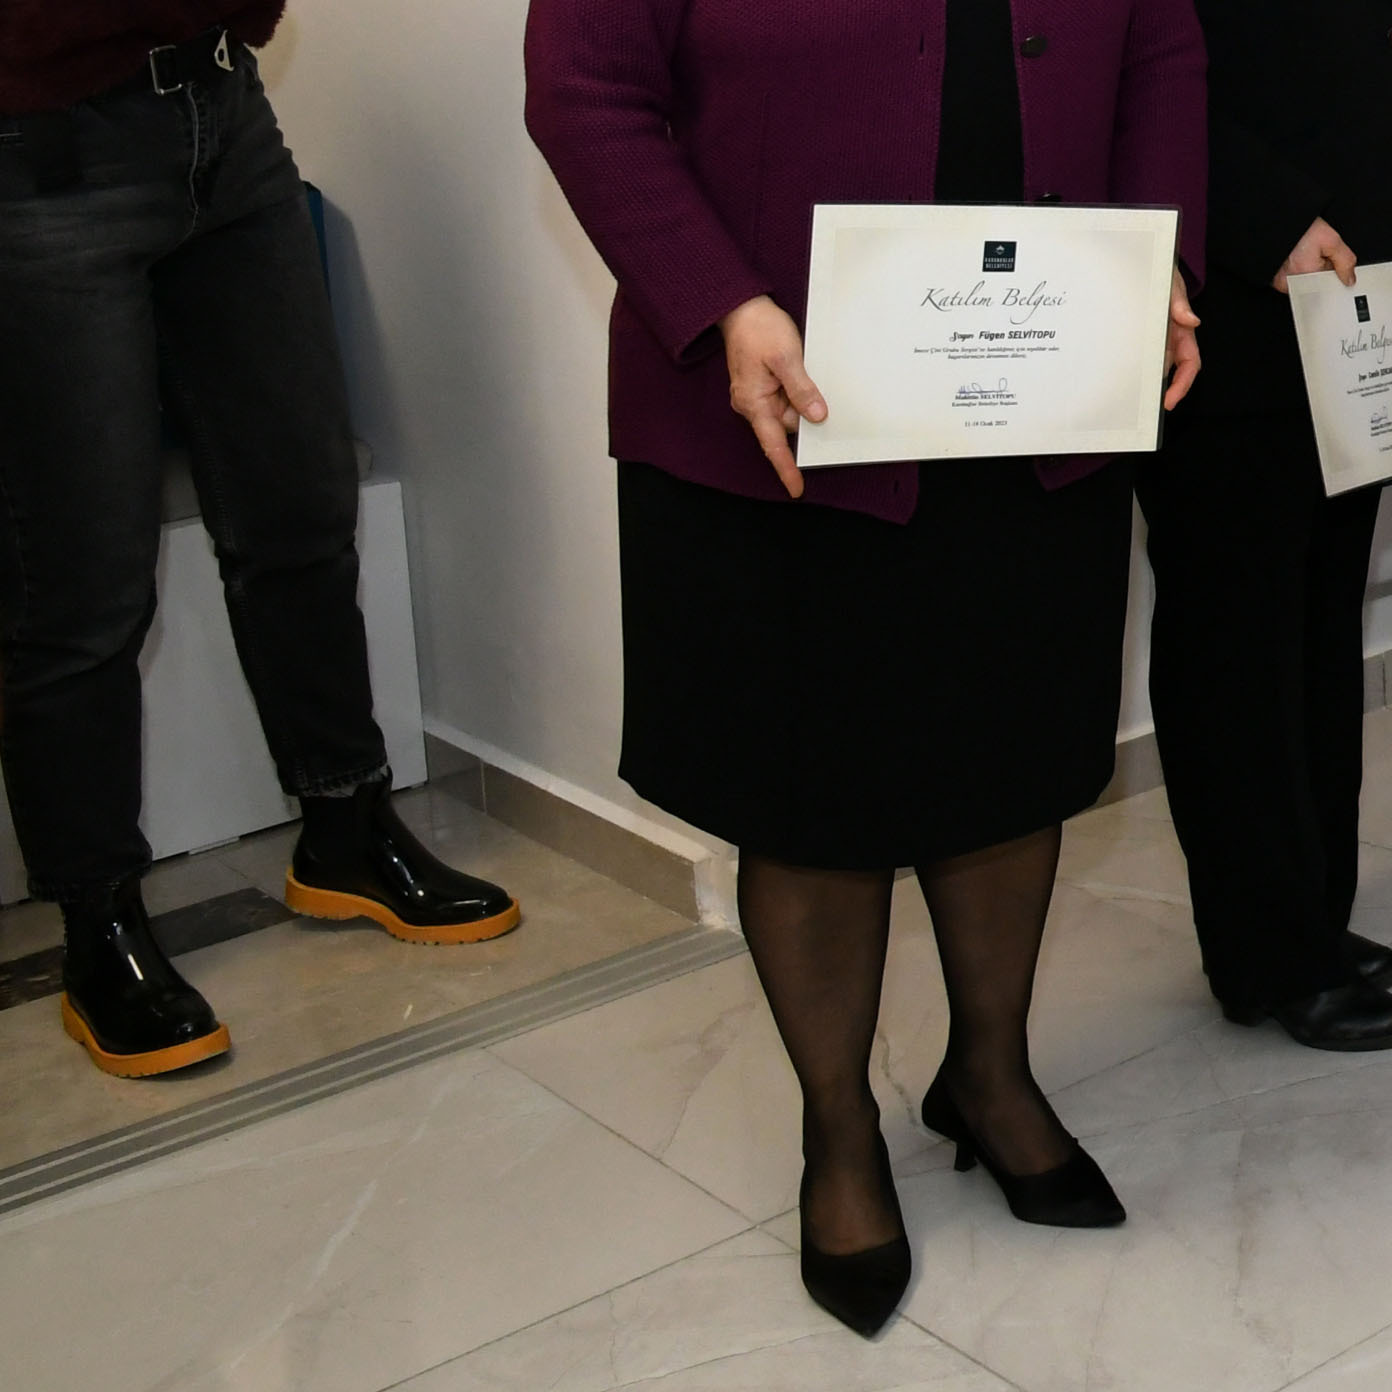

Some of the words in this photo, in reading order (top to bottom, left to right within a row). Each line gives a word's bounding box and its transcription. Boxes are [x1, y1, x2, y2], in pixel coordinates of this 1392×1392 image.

[920, 280, 993, 312] Katılım
[1002, 280, 1066, 325] Belgesi
[979, 331, 1005, 341] Fügen
[1008, 329, 1056, 339] SELVİTOPU
